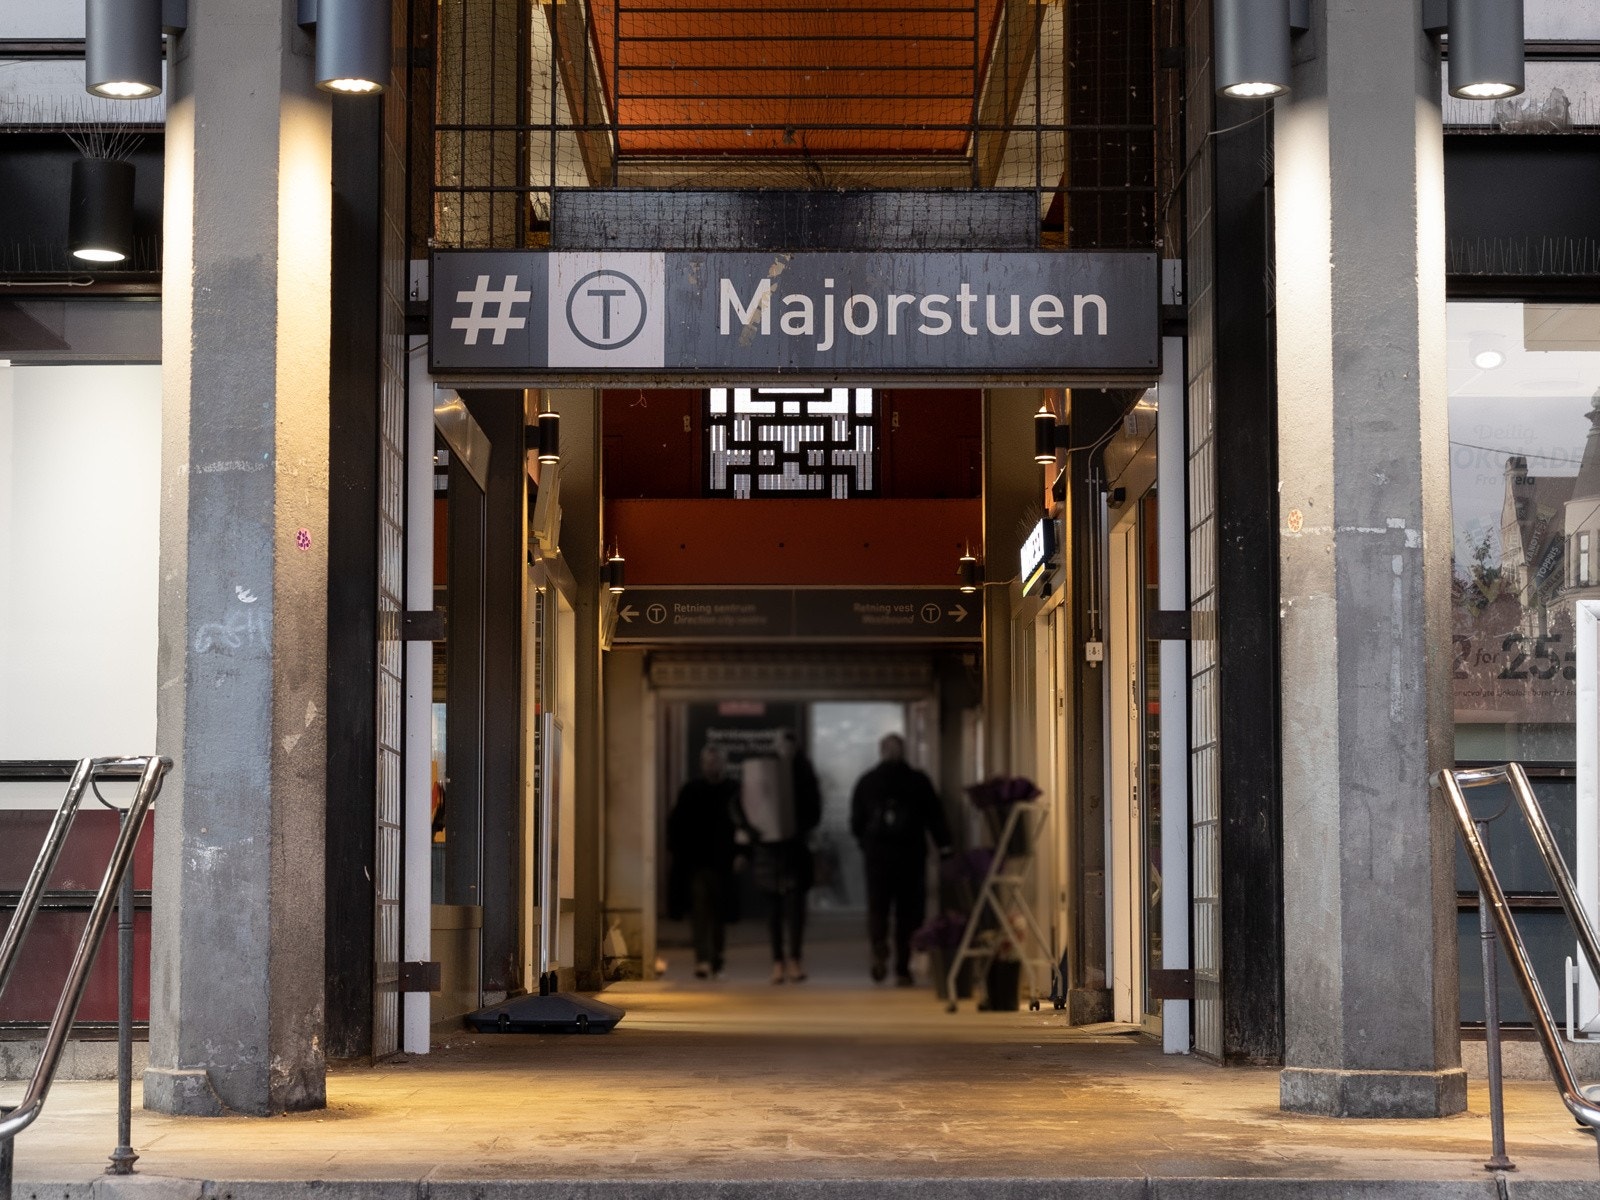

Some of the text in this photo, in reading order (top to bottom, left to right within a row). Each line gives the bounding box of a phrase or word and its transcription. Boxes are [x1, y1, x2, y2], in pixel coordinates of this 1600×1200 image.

[587, 289, 626, 340] T
[719, 278, 1108, 352] Majorstuen
[1536, 546, 1559, 578] TOPPRIS
[674, 603, 711, 615] Retning
[894, 603, 914, 612] vest
[1473, 647, 1499, 668] for
